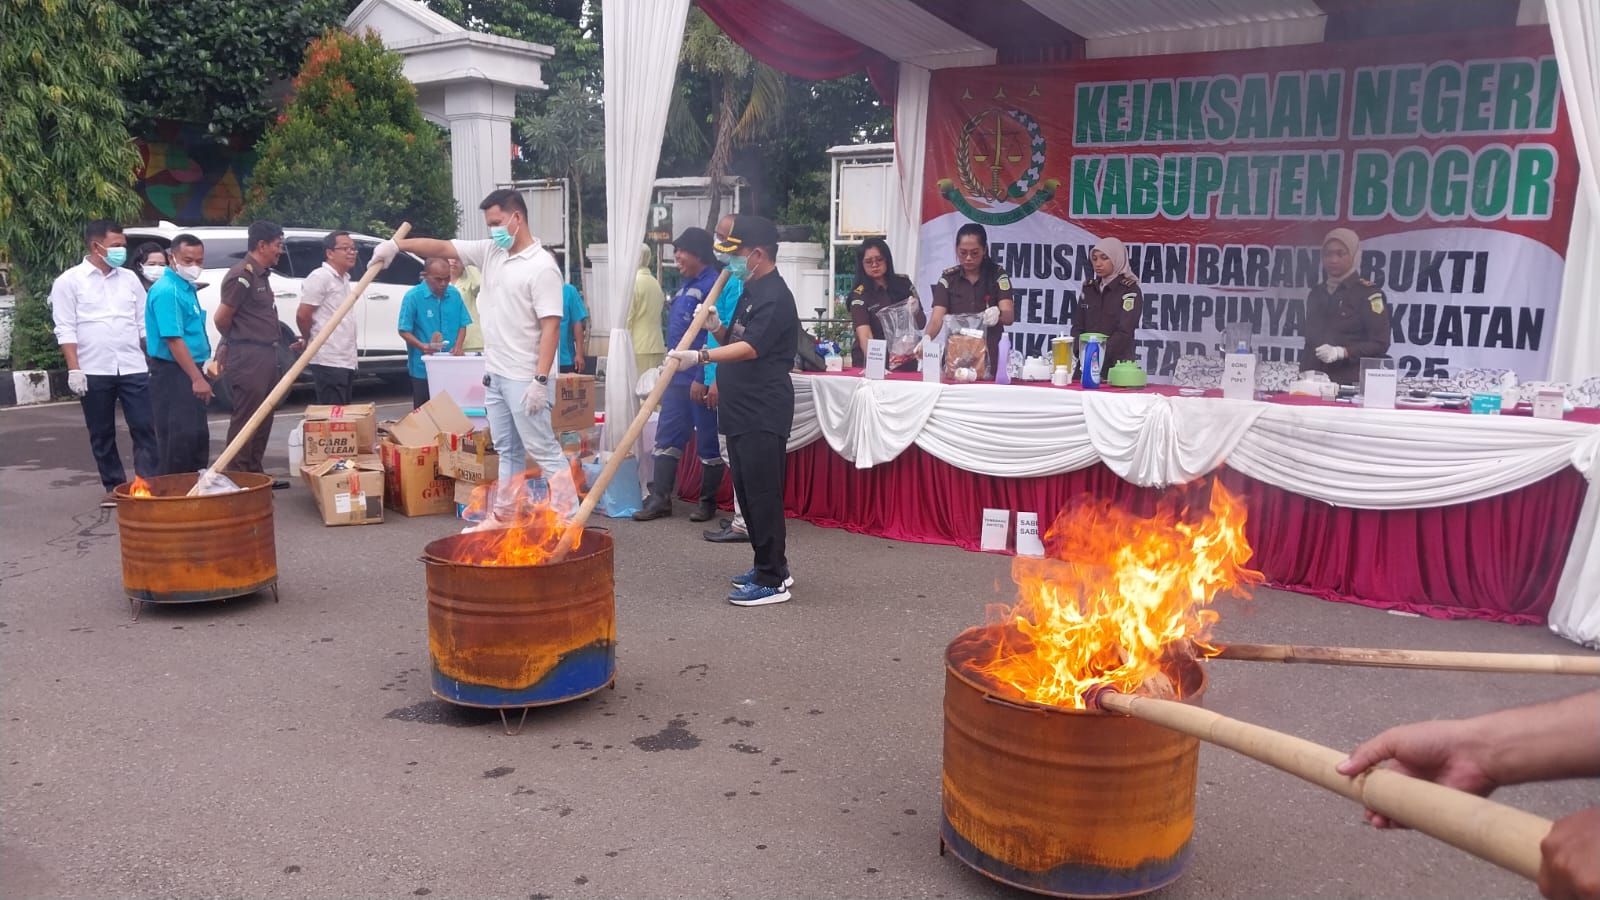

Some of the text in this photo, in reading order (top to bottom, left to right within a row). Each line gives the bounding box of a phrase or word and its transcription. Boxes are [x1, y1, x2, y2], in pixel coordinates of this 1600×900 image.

[1073, 57, 1560, 146] KEJAKSAAN NEGERI
[1070, 152, 1343, 219] KABUPATEN
[1349, 145, 1558, 221] BOGOR
[653, 206, 668, 227] P
[990, 242, 1489, 293] EMUSNHAN BARAN BUKTI
[1012, 287, 1545, 351] TELA EMPUNYA KUATAN
[1398, 354, 1450, 379] 25
[318, 438, 348, 447] CARB
[323, 446, 356, 455] CLEAN
